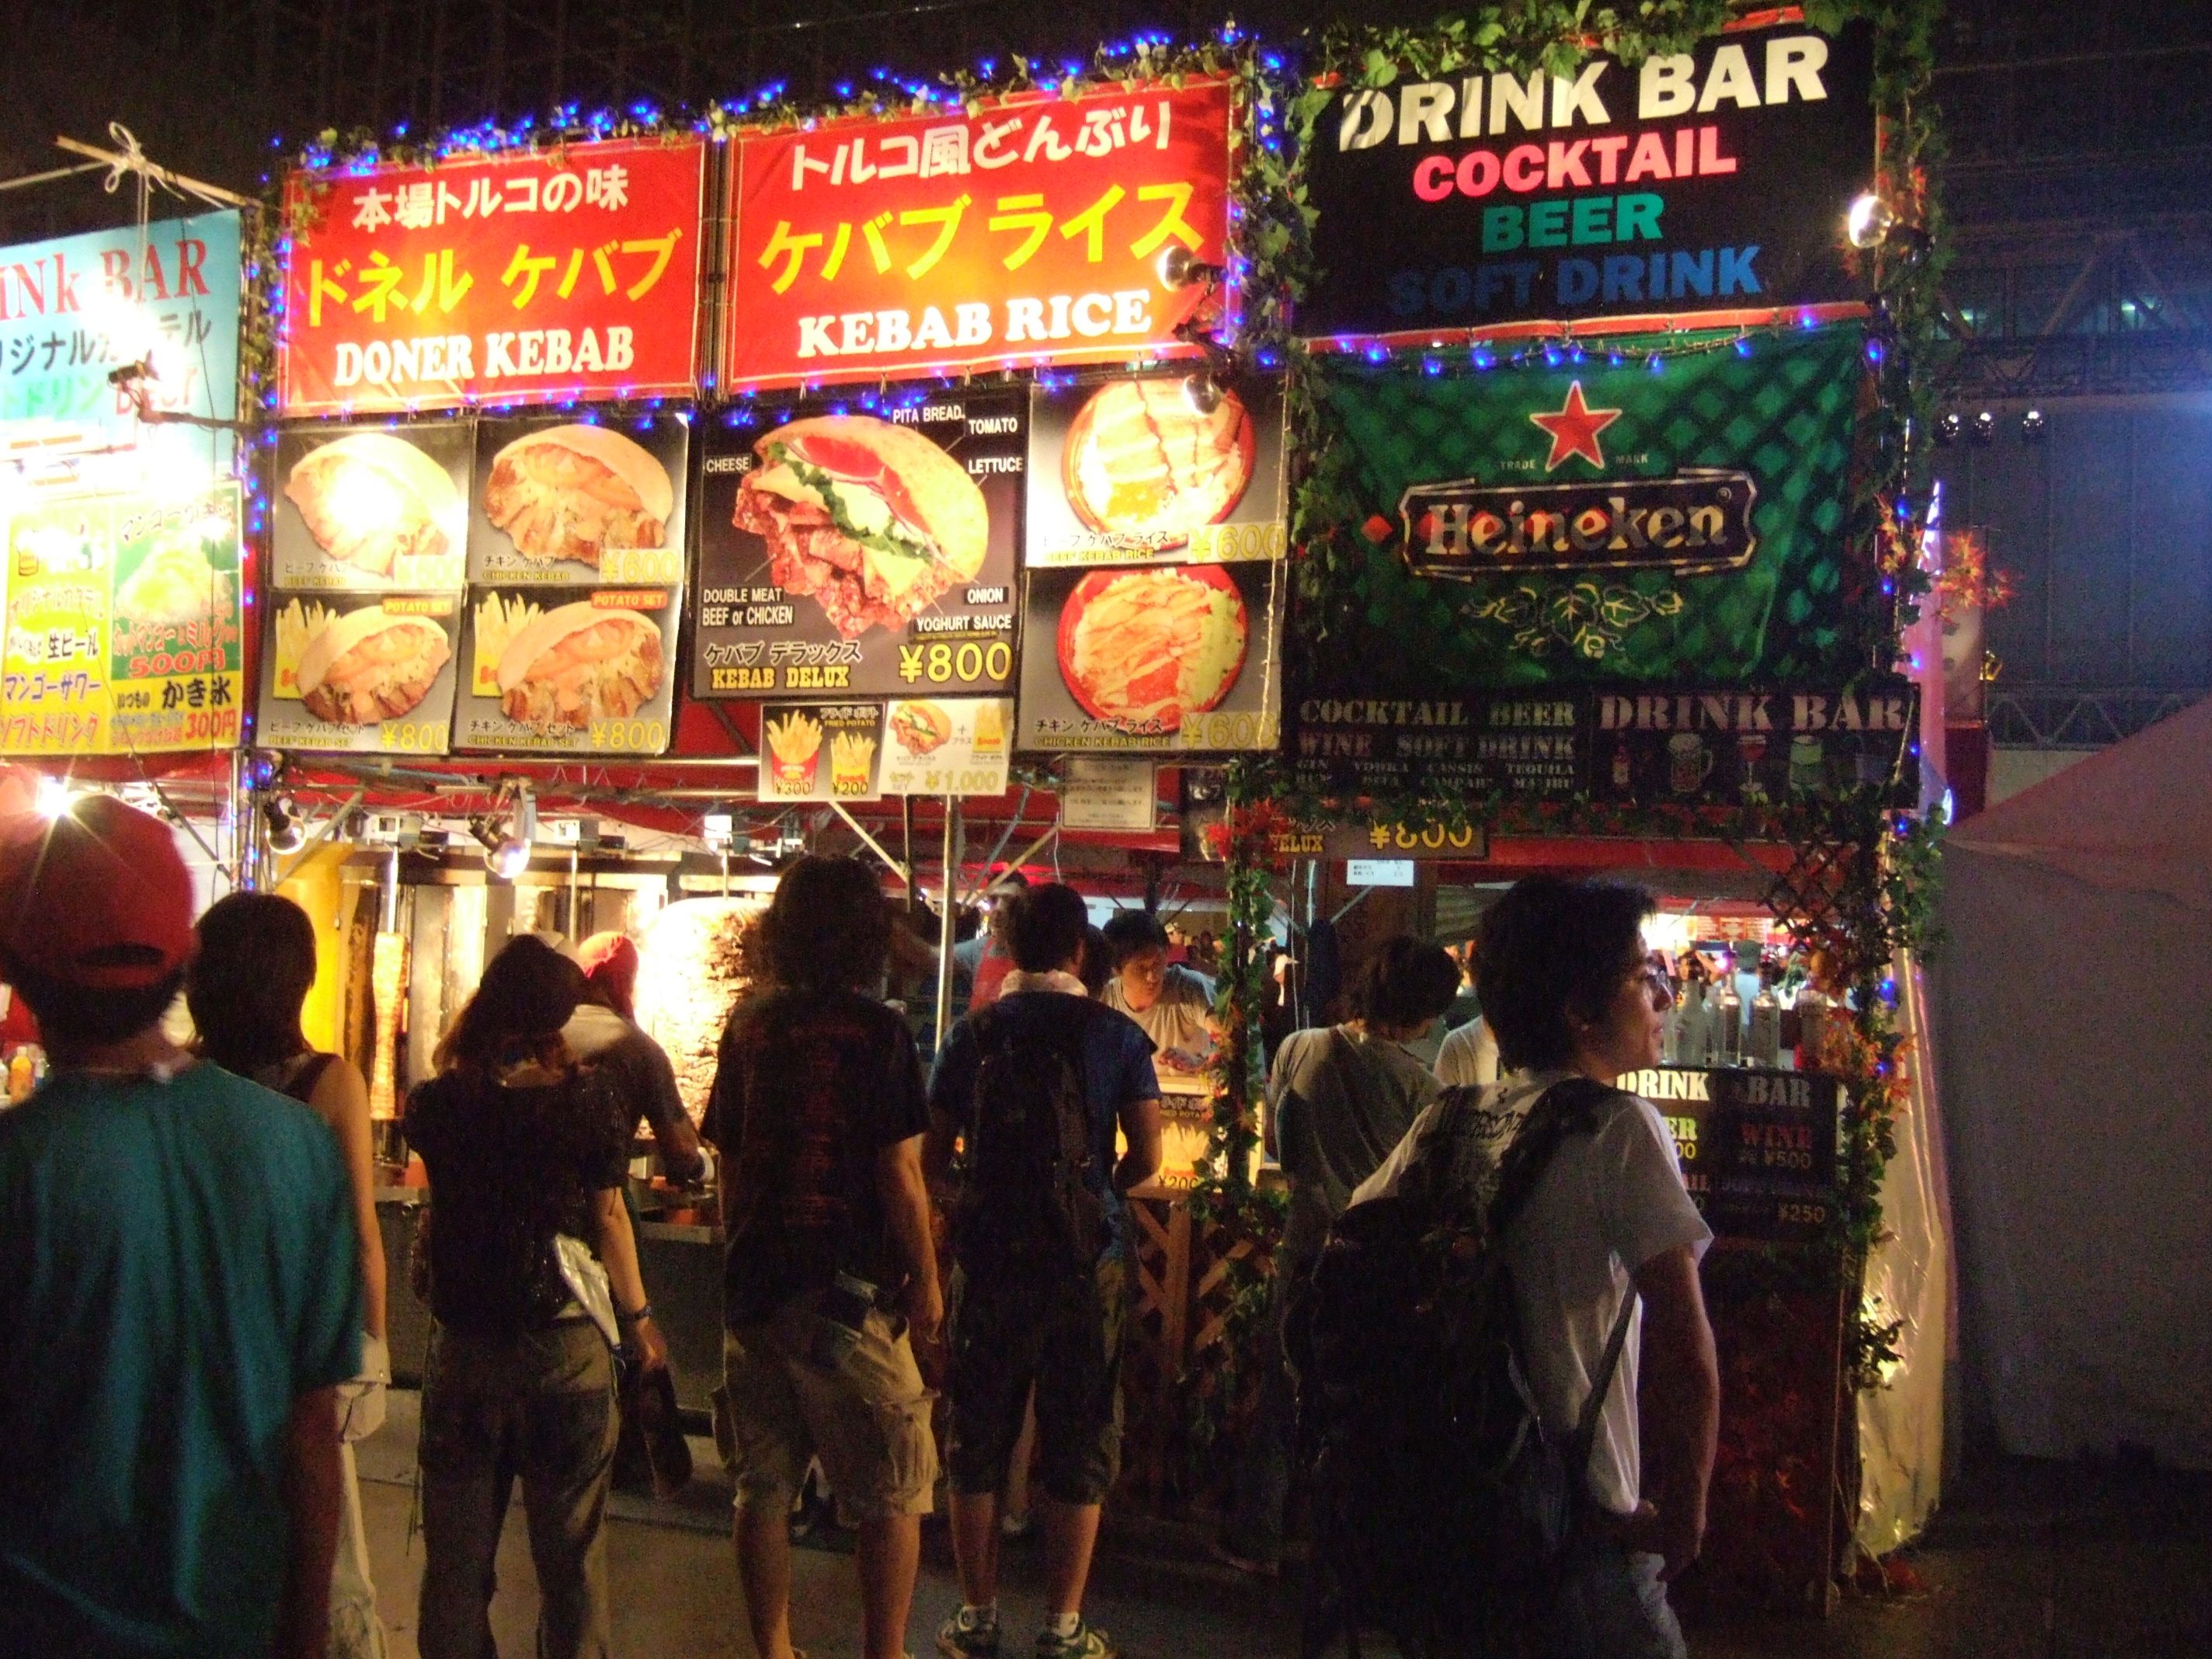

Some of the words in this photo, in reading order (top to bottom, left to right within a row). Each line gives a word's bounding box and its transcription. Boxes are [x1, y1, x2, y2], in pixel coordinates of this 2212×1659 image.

[1339, 60, 1612, 151] DRINK
[1638, 36, 1830, 119] BAR
[791, 102, 1171, 190] トルコ風どんぶり
[1413, 127, 1737, 202] COCKTAIL
[353, 164, 628, 232] 本場トルコの味
[1482, 193, 1664, 253] BEER
[758, 193, 972, 295] ケバブ
[989, 183, 1204, 271] ライス
[101, 238, 210, 303] BAR
[309, 250, 474, 326] ドネル
[501, 228, 683, 310] ケバブ
[1390, 259, 1543, 314] SOFT
[1556, 245, 1762, 304] DRINK
[798, 303, 992, 358] KEBAB
[1005, 289, 1152, 341] RICE
[333, 336, 475, 386] DONER
[485, 326, 635, 379] KEBAB
[893, 409, 919, 423] PITA
[923, 405, 962, 422] BREAD
[969, 417, 1017, 433] TOMATO
[706, 457, 750, 472] CHEESE
[969, 457, 1023, 474] LETTUCE
[1500, 459, 1536, 470] TRADE
[1132, 530, 1170, 544] ライス
[1425, 497, 1730, 555] Heineken
[1080, 550, 1122, 561] KEBAB
[1125, 548, 1155, 559] RICE
[1190, 523, 1284, 562] ¥600
[482, 571, 530, 581] CHICKEN
[534, 571, 569, 581] KEBAB
[484, 555, 517, 569] チキン
[601, 551, 678, 583] ¥600
[385, 601, 429, 613] POTATO
[593, 595, 638, 606] POTATO
[643, 593, 664, 606] SET
[704, 589, 748, 603] DOUBLE
[751, 588, 782, 602] MEAT
[967, 588, 1003, 603] ONION
[703, 610, 729, 625] BEEF
[732, 611, 745, 624] or
[746, 607, 793, 624] CHICKEN
[916, 616, 970, 631] YOGHURT
[973, 614, 1012, 630] SAUCE
[130, 647, 225, 679] 500円
[704, 641, 764, 665] ケバブ
[770, 639, 862, 664] デラックス
[899, 641, 1011, 683] ¥800
[711, 666, 775, 689] KEBAB
[786, 666, 851, 688] DELUX
[162, 676, 231, 709] かき氷
[185, 708, 237, 740] 300円
[1035, 718, 1074, 733] チキン
[1126, 718, 1163, 733] ライス
[1299, 700, 1469, 726] COCKTAIL
[1489, 701, 1576, 726] BEER
[1600, 695, 1773, 731] DRINK
[1791, 695, 1906, 731] BAR
[381, 722, 448, 750] ¥800
[591, 720, 663, 750] ¥800
[1034, 737, 1090, 748] CHICKEN
[1094, 737, 1137, 747] KEBAB
[1141, 736, 1171, 747] RICE
[1181, 713, 1278, 748] ¥600
[775, 781, 810, 795] ¥300
[833, 781, 868, 795] ¥200
[1617, 1069, 1710, 1101] DRINK
[1748, 1076, 1810, 1108] BAR
